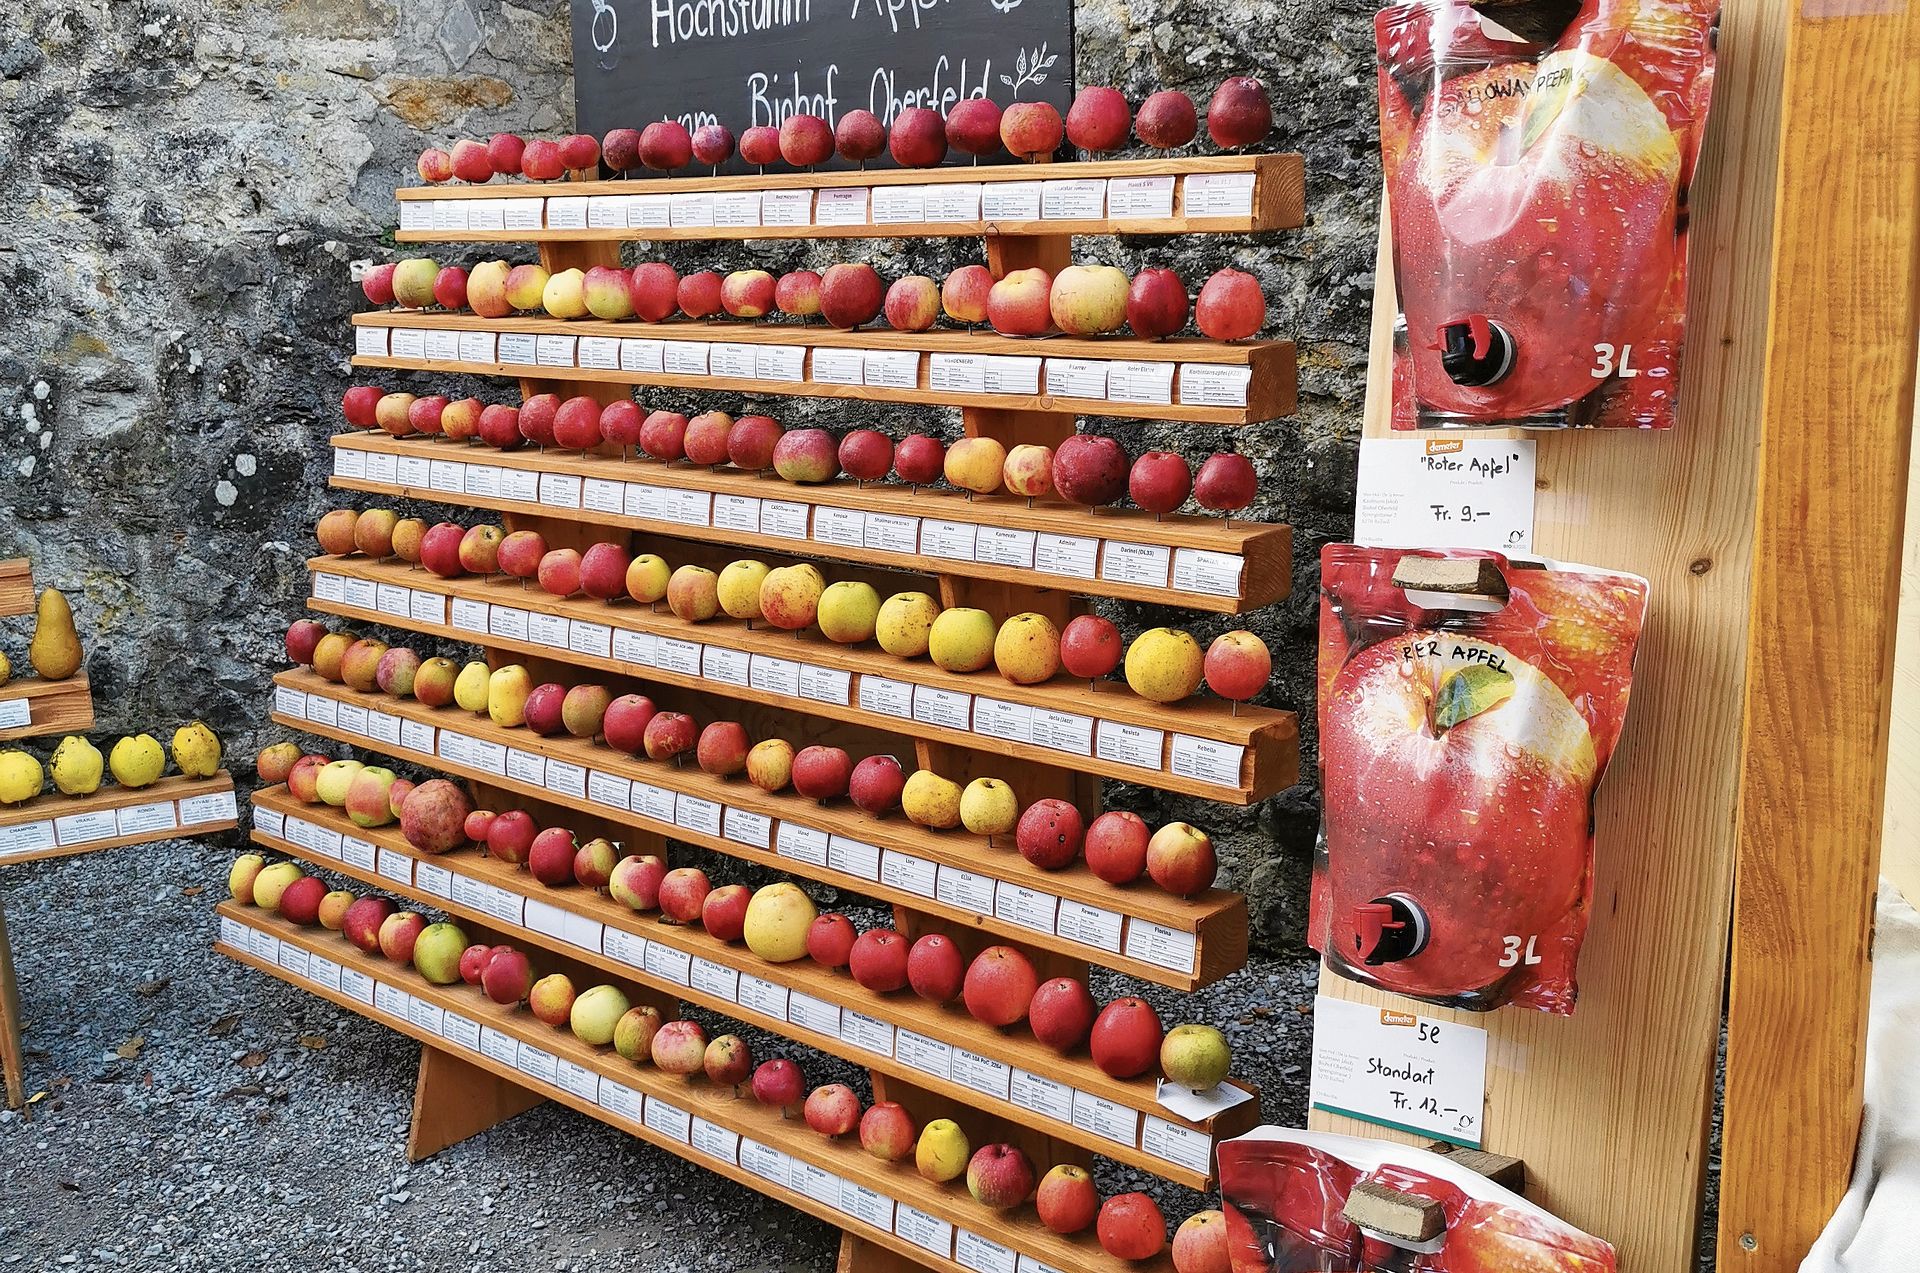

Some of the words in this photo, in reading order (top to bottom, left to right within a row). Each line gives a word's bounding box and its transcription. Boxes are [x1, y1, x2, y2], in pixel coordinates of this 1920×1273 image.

[1590, 343, 1638, 379] 3L
[1428, 441, 1460, 452] demeter
[1430, 504, 1452, 522] Fr.
[1451, 645, 1507, 674] APFEL
[9, 825, 38, 834] CHAMPION
[1018, 889, 1034, 900] Regine
[1154, 926, 1172, 938] Florina
[1498, 934, 1542, 968] 3L
[1383, 1011, 1414, 1024] demeter
[1366, 1057, 1436, 1086] Standart
[1390, 1090, 1412, 1111] Fr.
